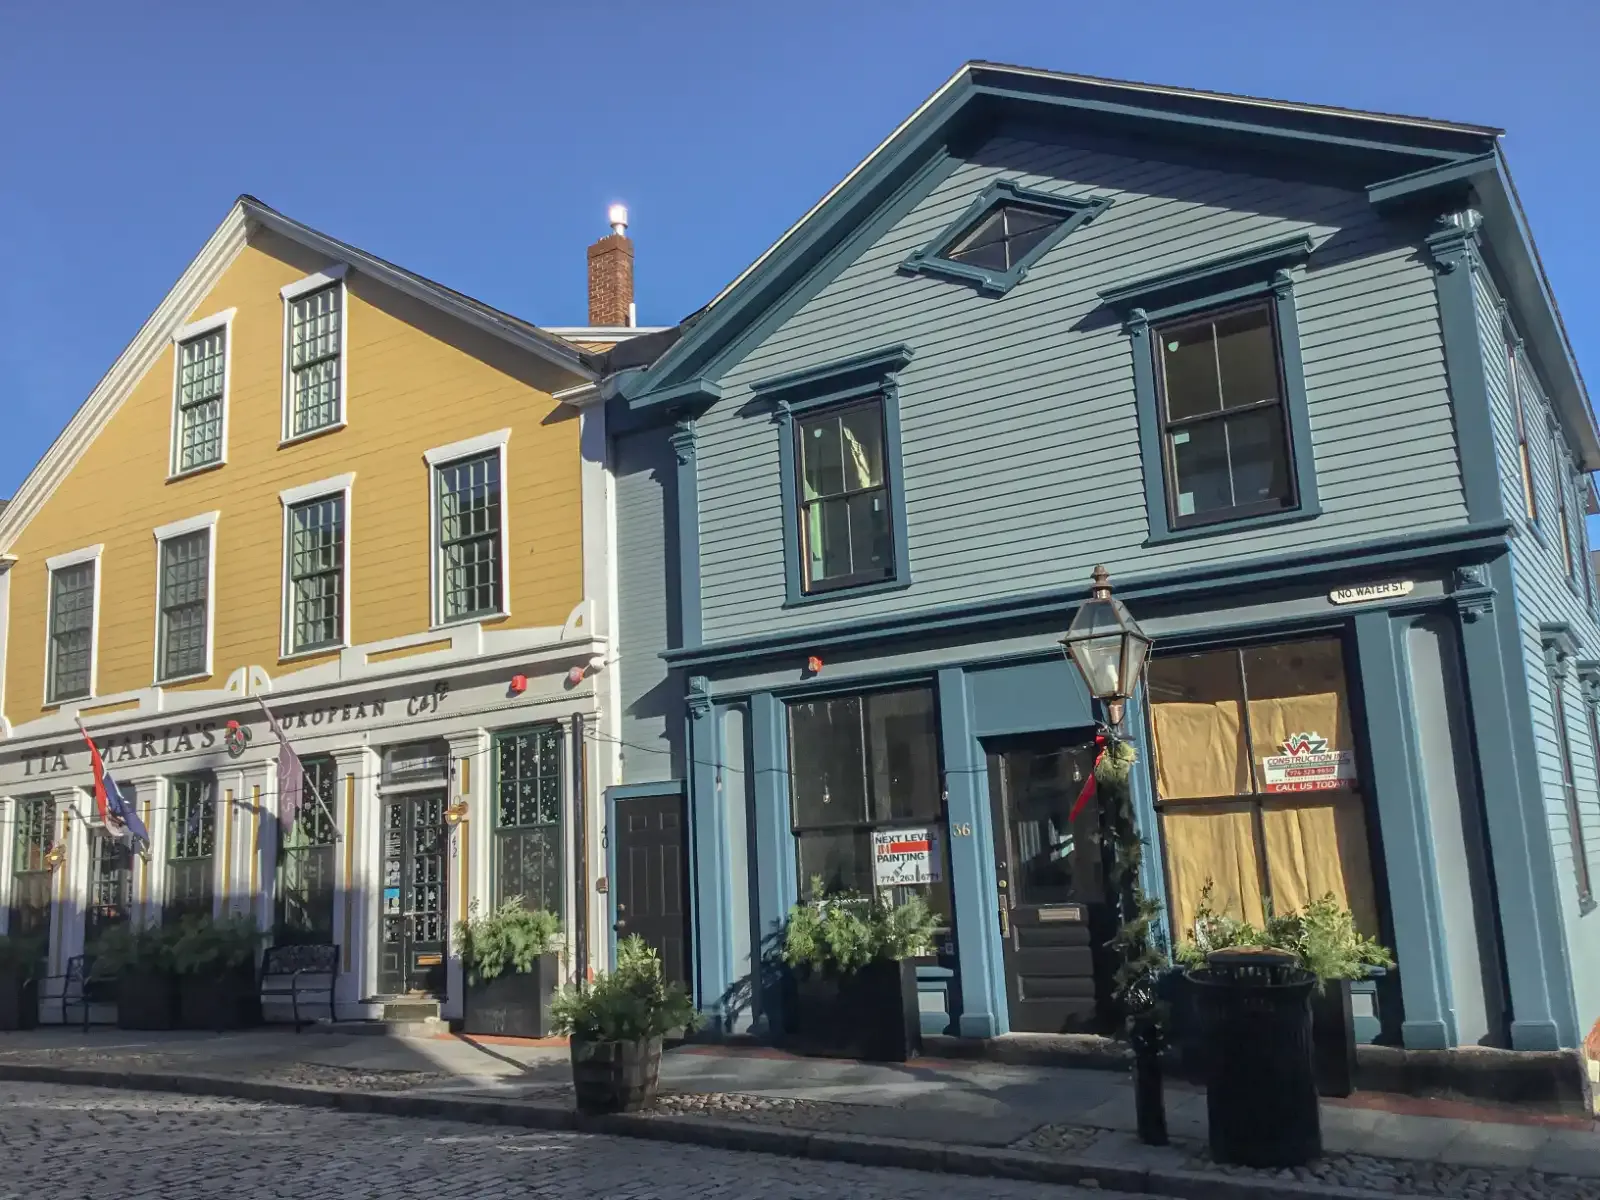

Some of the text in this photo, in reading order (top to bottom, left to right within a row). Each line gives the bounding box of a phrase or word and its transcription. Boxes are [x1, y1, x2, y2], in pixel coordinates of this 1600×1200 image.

[1356, 584, 1389, 597] WATER
[21, 748, 69, 776] TIA
[1267, 754, 1331, 765] CONSTRUCTION
[1275, 784, 1297, 792] CALL
[875, 832, 937, 844] NEXT LEVEL
[877, 852, 925, 863] PAINTING
